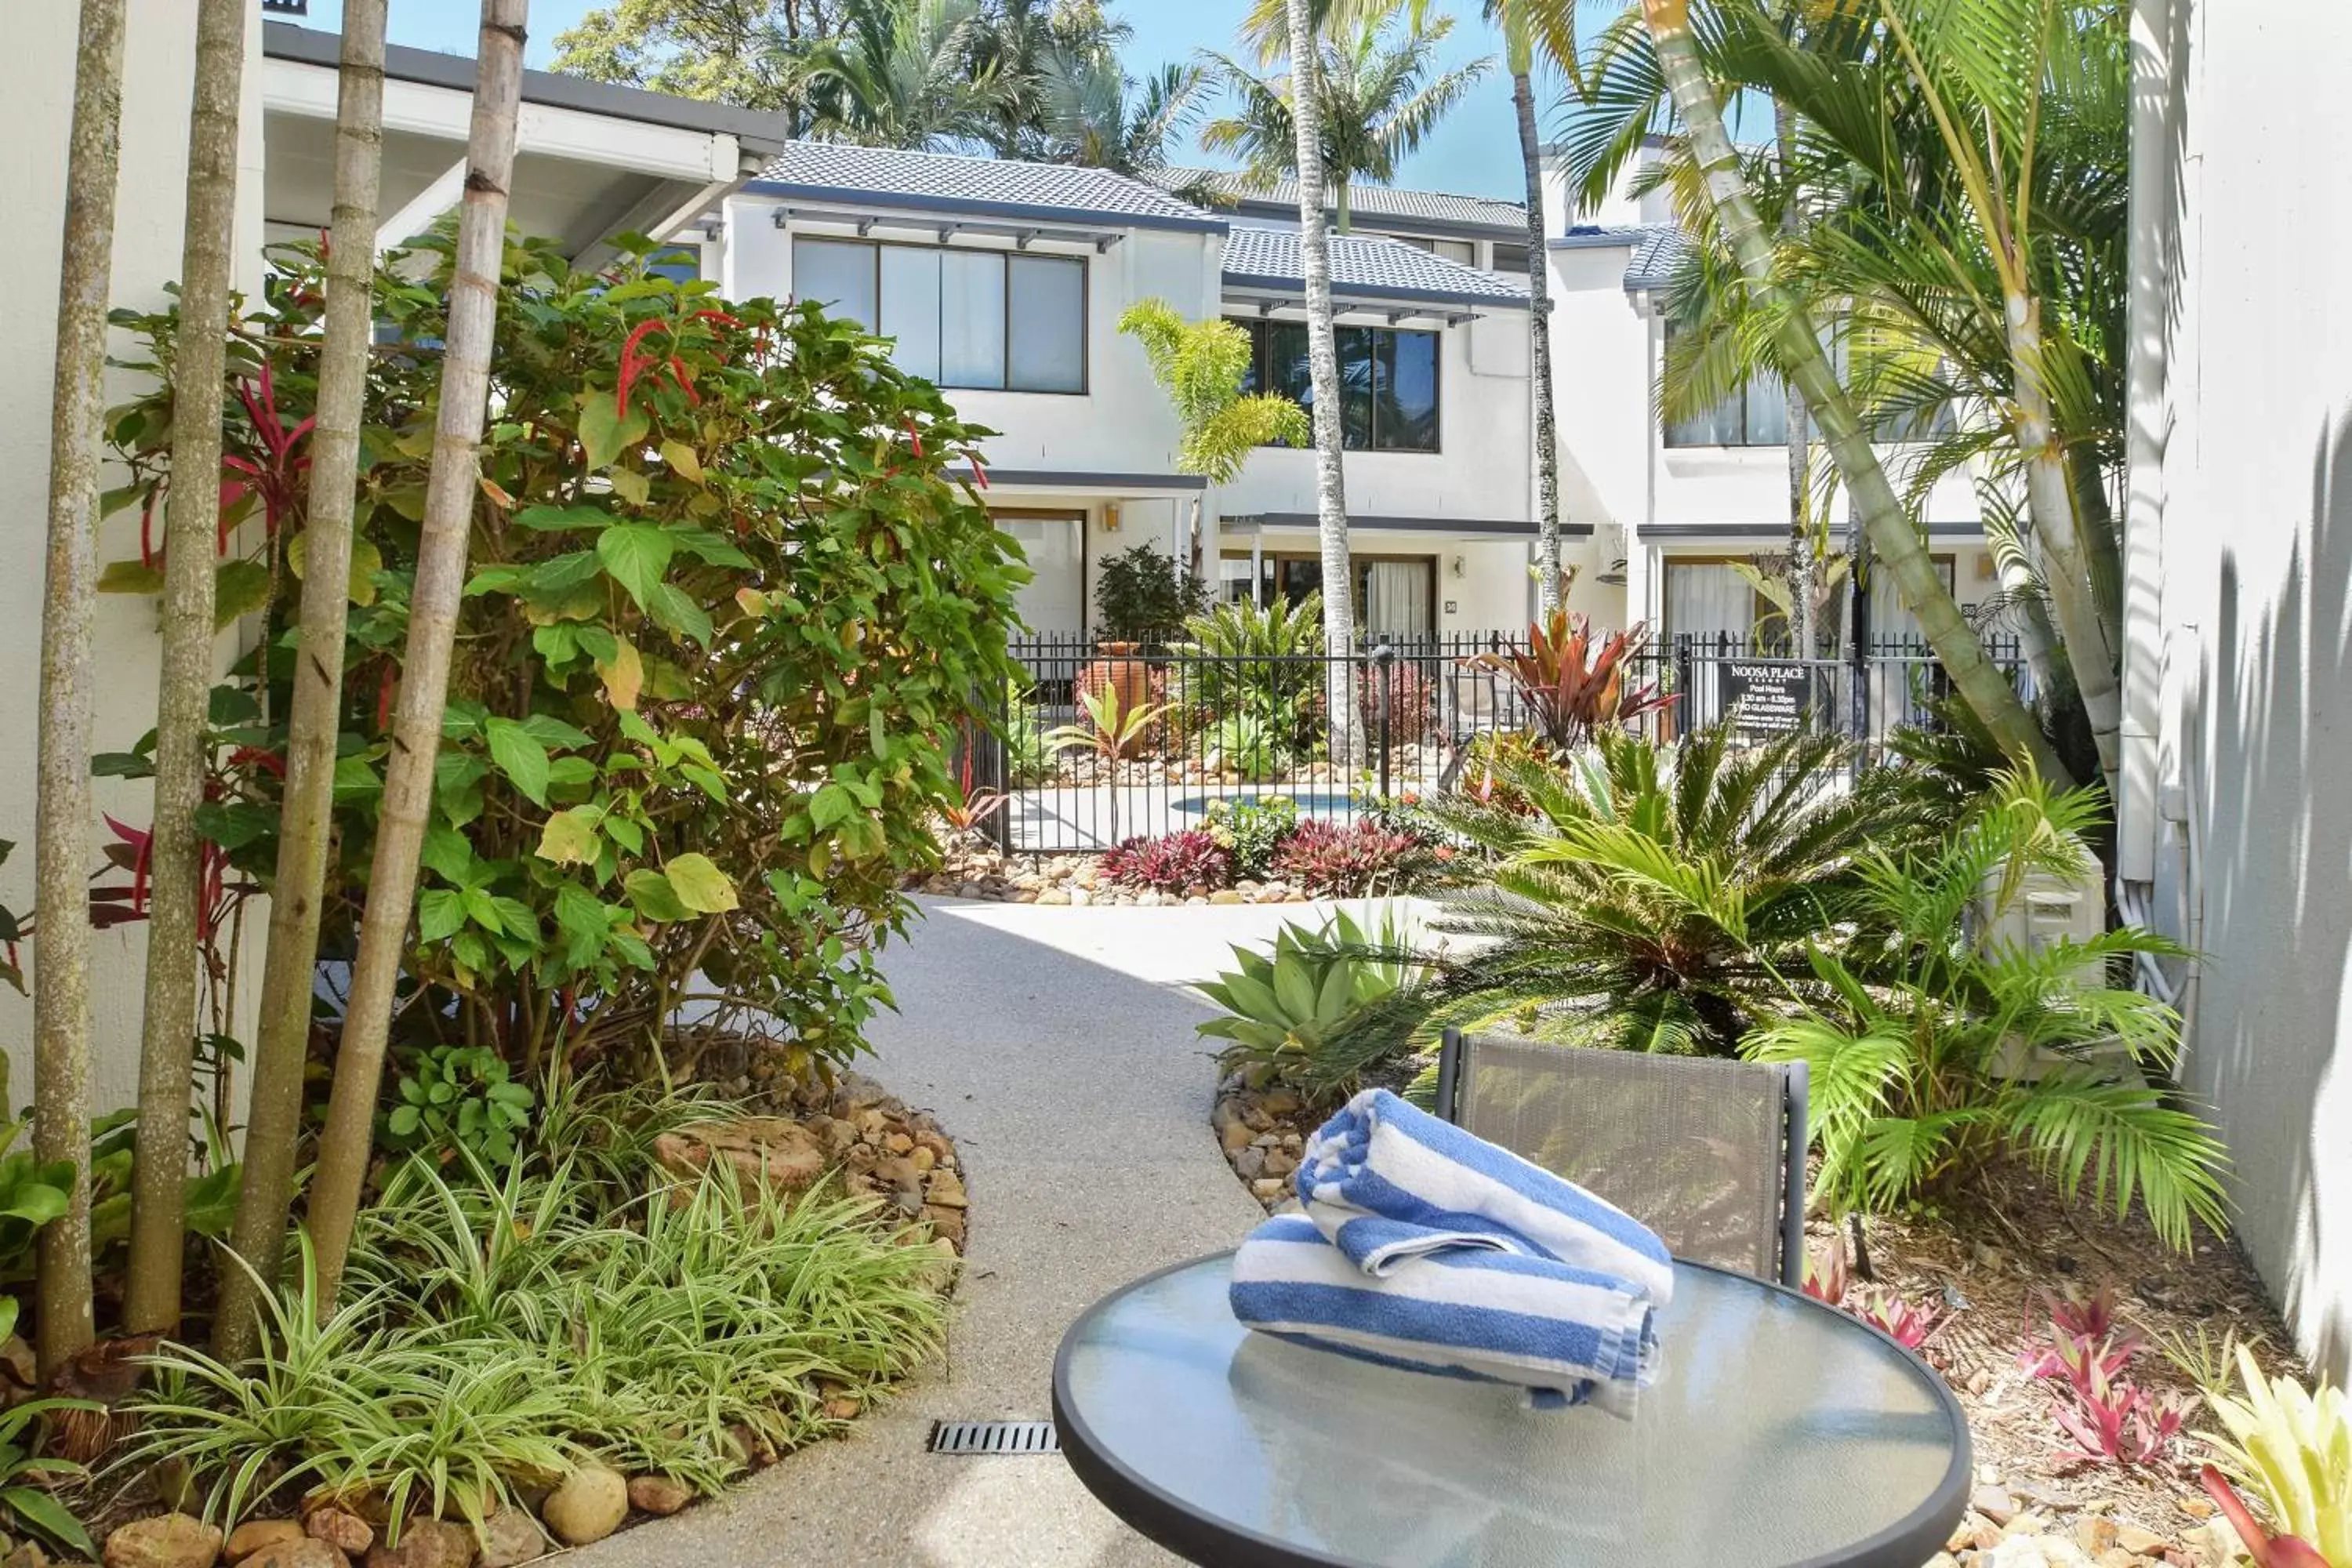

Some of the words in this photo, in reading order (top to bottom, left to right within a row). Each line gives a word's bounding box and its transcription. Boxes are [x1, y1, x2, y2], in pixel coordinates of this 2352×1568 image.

[1731, 665, 1769, 678] NOOSA
[1769, 666, 1805, 679] PLACE
[1766, 684, 1785, 694] Hours
